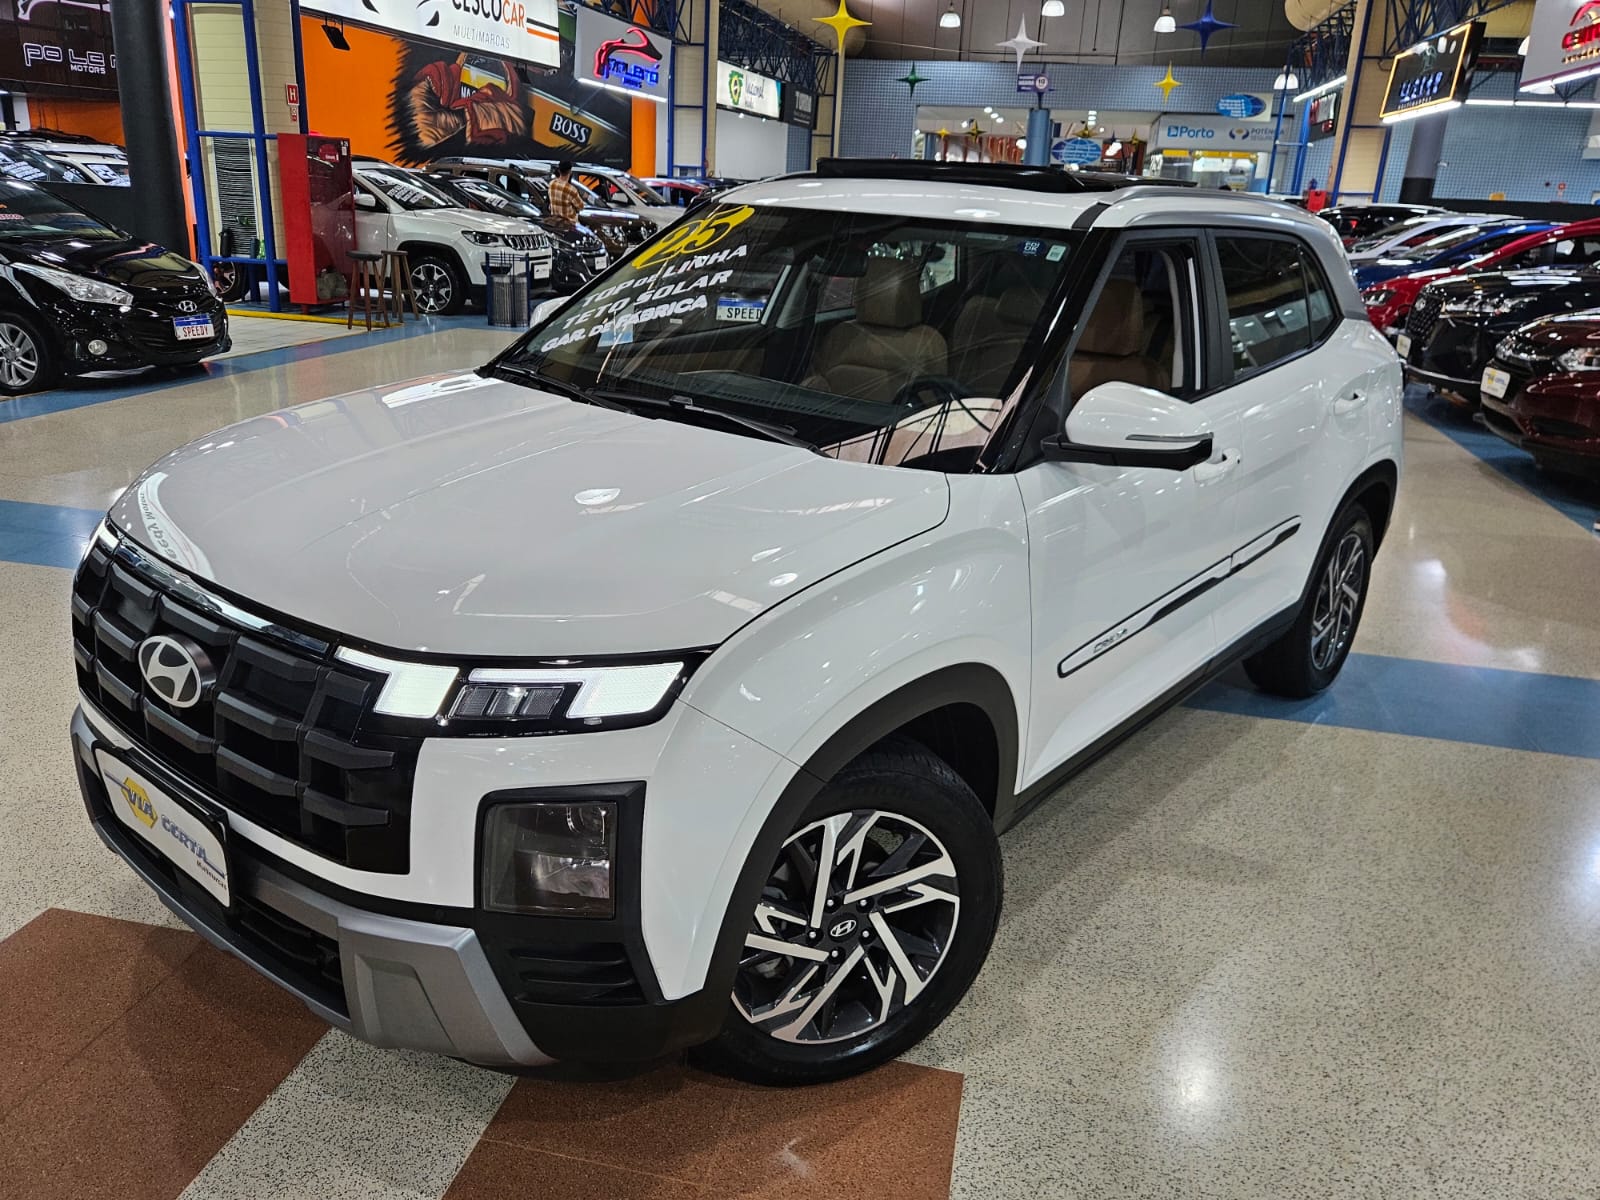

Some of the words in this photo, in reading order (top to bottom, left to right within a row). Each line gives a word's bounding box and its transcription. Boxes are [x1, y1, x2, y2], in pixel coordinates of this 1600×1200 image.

[453, 25, 511, 49] MULTIMARCAS
[70, 64, 106, 74] MOTORS
[289, 88, 297, 101] H
[552, 114, 589, 143] BOSS
[1180, 126, 1214, 138] Porto
[632, 204, 755, 269] 25
[583, 279, 635, 307] TOP
[662, 244, 747, 278] LINHA
[562, 297, 631, 329] TETO
[633, 269, 733, 305] SOLAR
[183, 325, 209, 337] SPEEDY
[127, 789, 154, 817] VIA
[161, 814, 207, 862] CERTA
